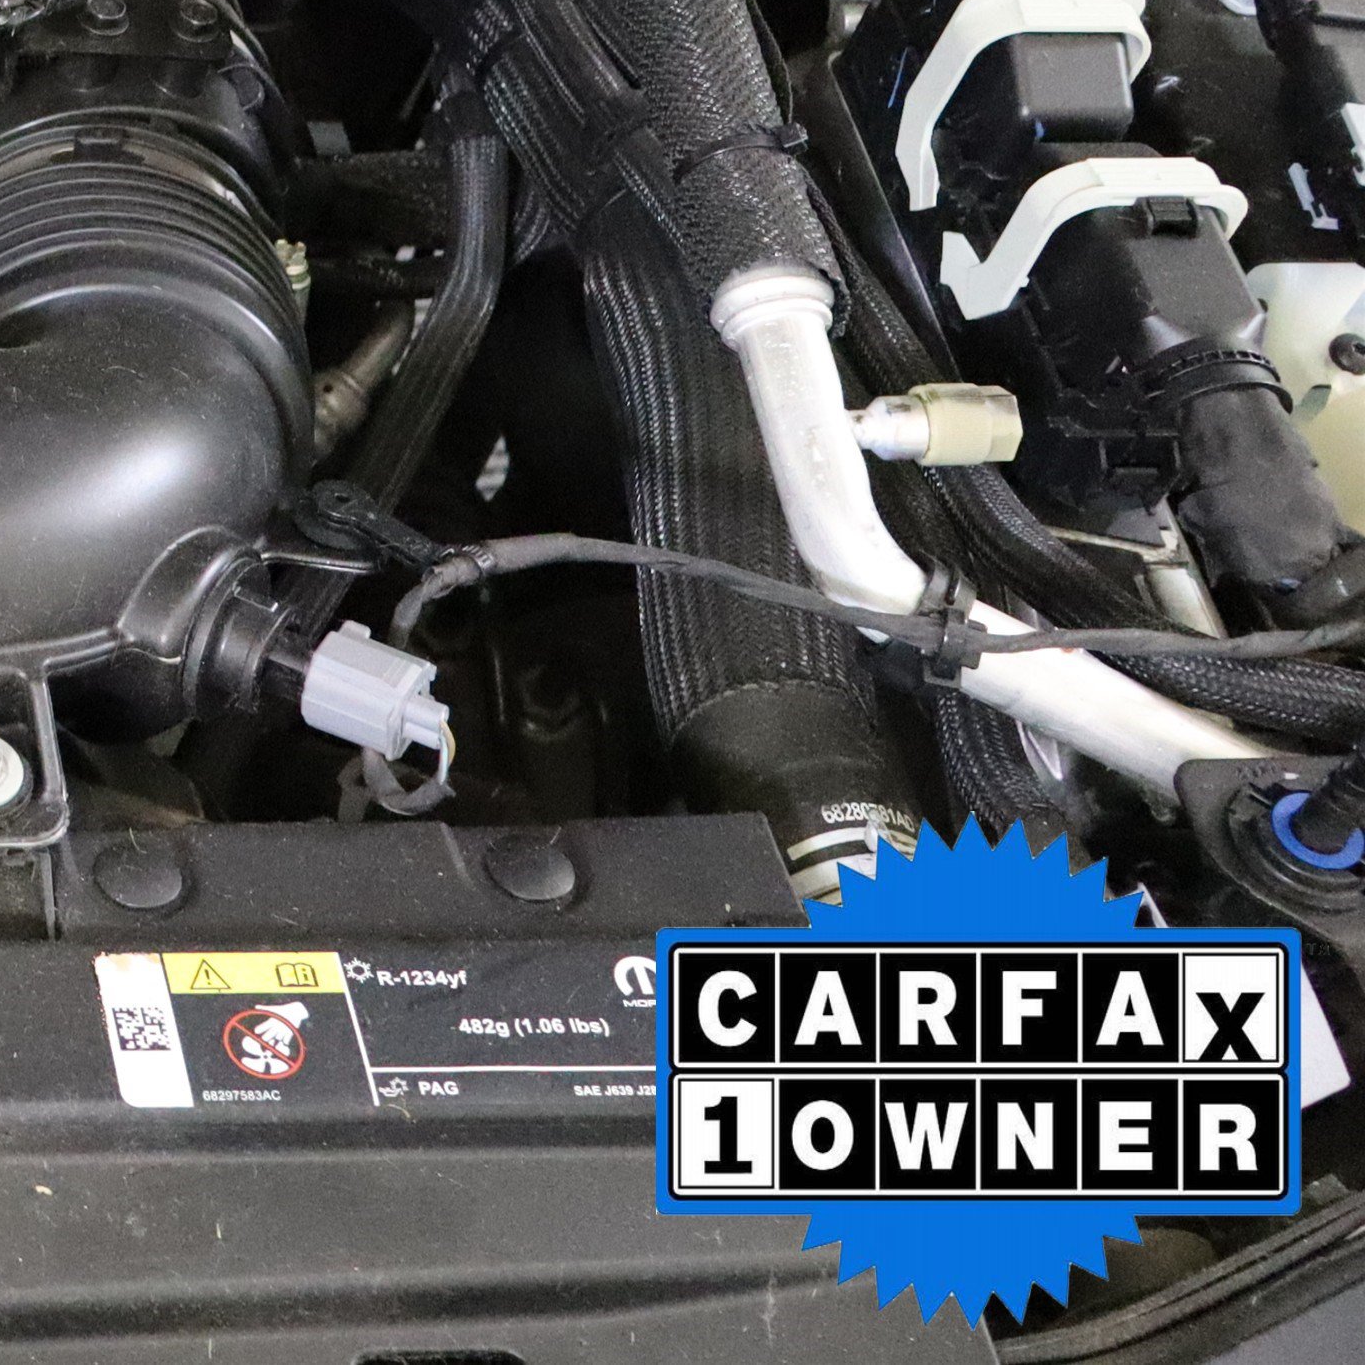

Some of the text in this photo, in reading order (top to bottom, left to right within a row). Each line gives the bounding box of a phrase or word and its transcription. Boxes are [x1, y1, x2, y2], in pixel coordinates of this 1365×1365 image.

[376, 969, 468, 990] R-1234yf
[458, 1016, 612, 1039] 482g (1.06 lbs)
[201, 1089, 283, 1103] 68297583AC
[417, 1080, 461, 1097] PAG
[572, 1084, 603, 1097] SAE
[604, 1084, 635, 1097] J639
